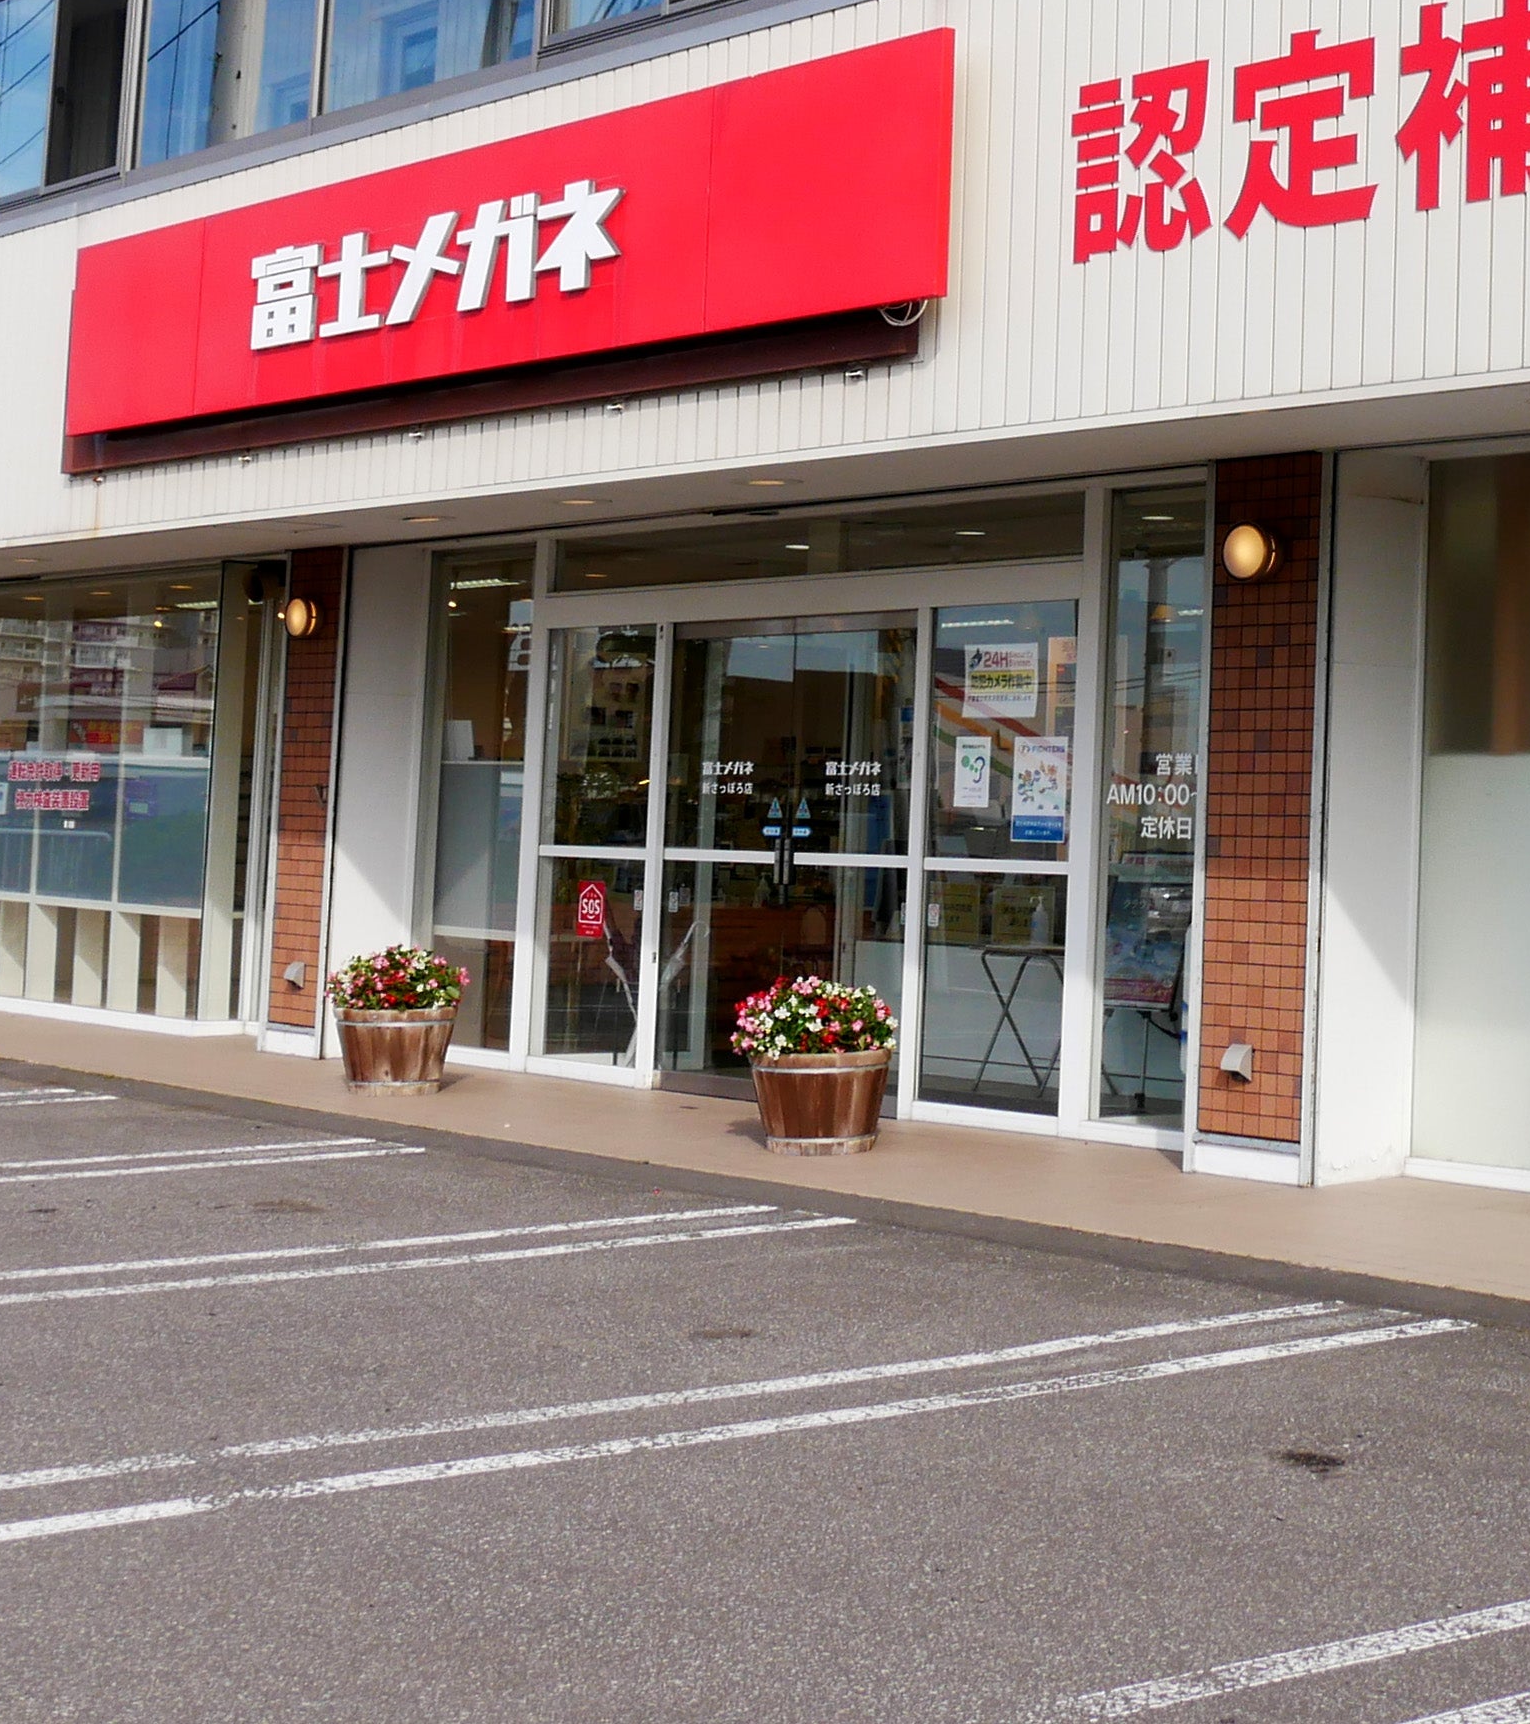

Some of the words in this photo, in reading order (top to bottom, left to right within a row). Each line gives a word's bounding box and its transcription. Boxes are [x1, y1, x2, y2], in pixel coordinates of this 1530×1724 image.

[249, 178, 627, 352] 富士メガネ
[983, 650, 1009, 669] 24H
[702, 761, 755, 776] 富士メガネ
[825, 761, 882, 777] 富士メガネ
[1155, 753, 1199, 776] 営業
[702, 782, 754, 796] 新さっぽろ店
[825, 783, 882, 797] 新さっぽろ店
[1140, 816, 1193, 840] 定休日
[581, 897, 601, 916] SOS
